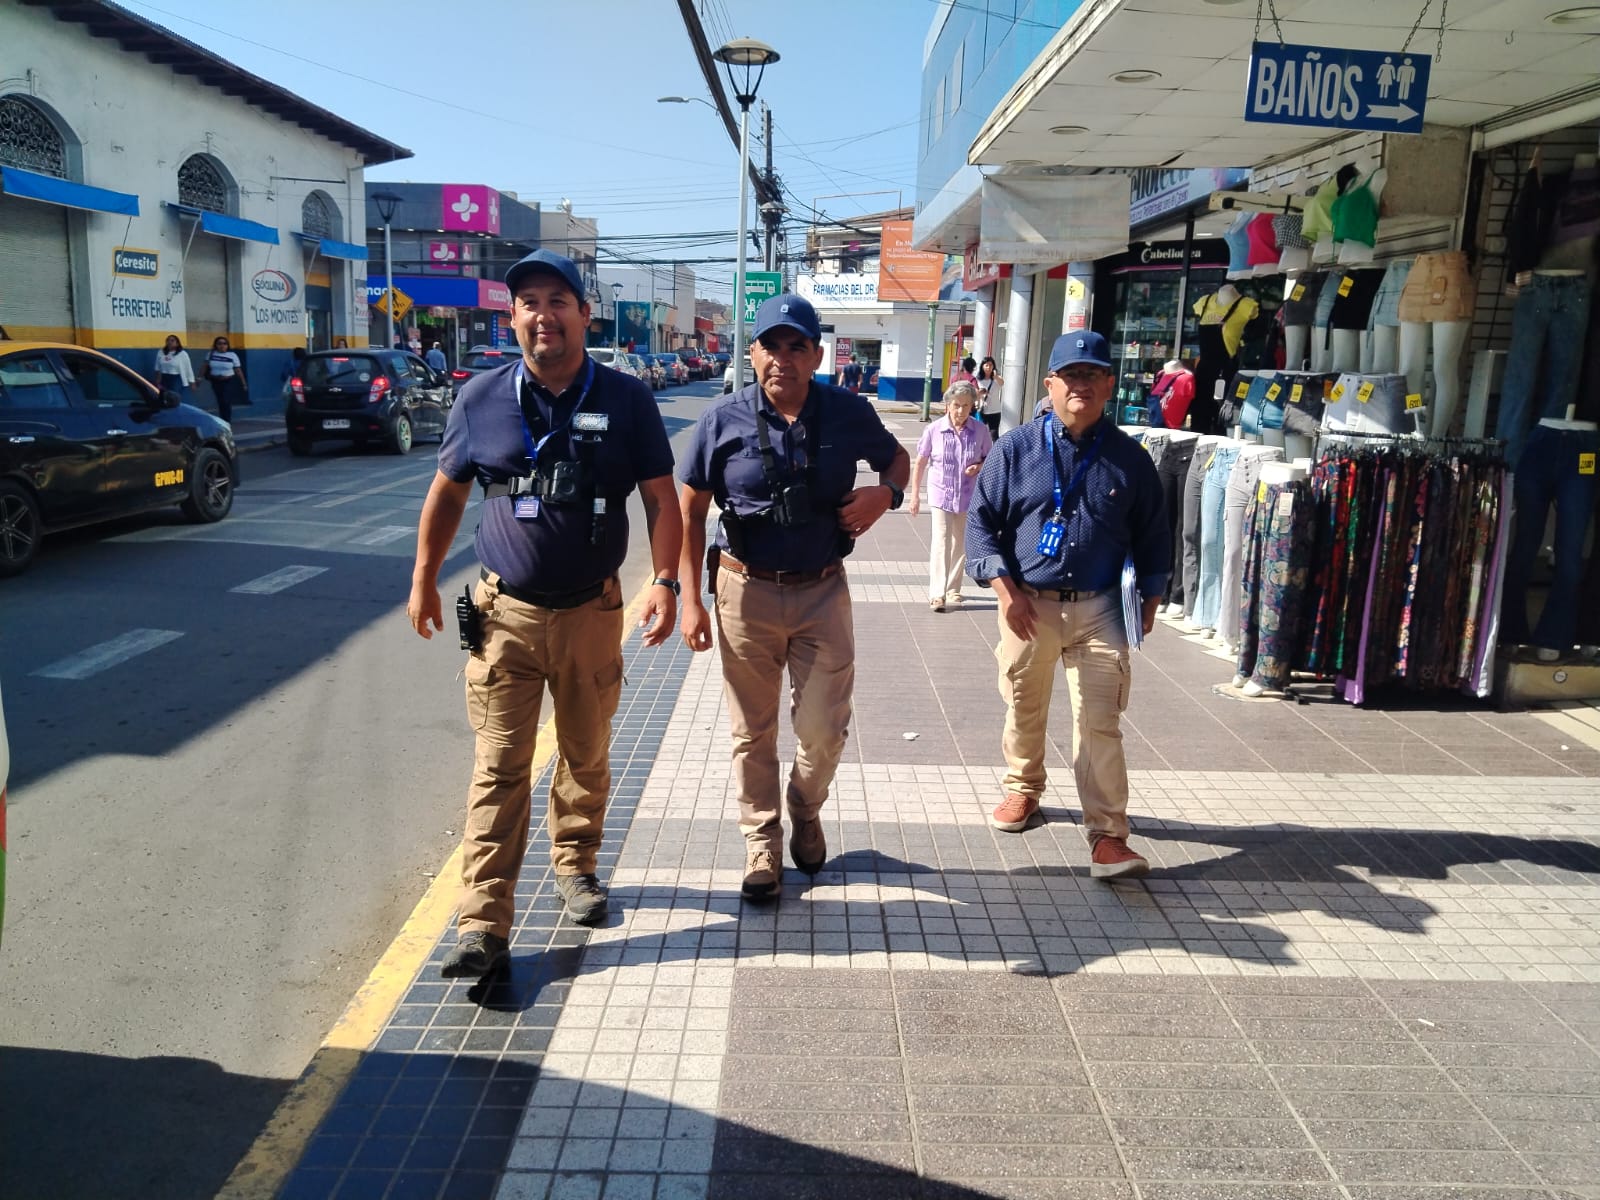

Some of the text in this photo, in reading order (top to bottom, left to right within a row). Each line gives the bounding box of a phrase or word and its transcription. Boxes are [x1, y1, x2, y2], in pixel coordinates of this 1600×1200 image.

[1253, 51, 1363, 121] BAÑOS
[115, 253, 157, 272] Ceresita
[1141, 247, 1201, 264] Cabellotca
[255, 279, 285, 292] SOQUINA
[813, 284, 849, 295] FARMACIAS
[850, 284, 863, 295] DEL
[112, 297, 172, 318] FERRETERIA
[255, 308, 299, 324] LOS MONTES
